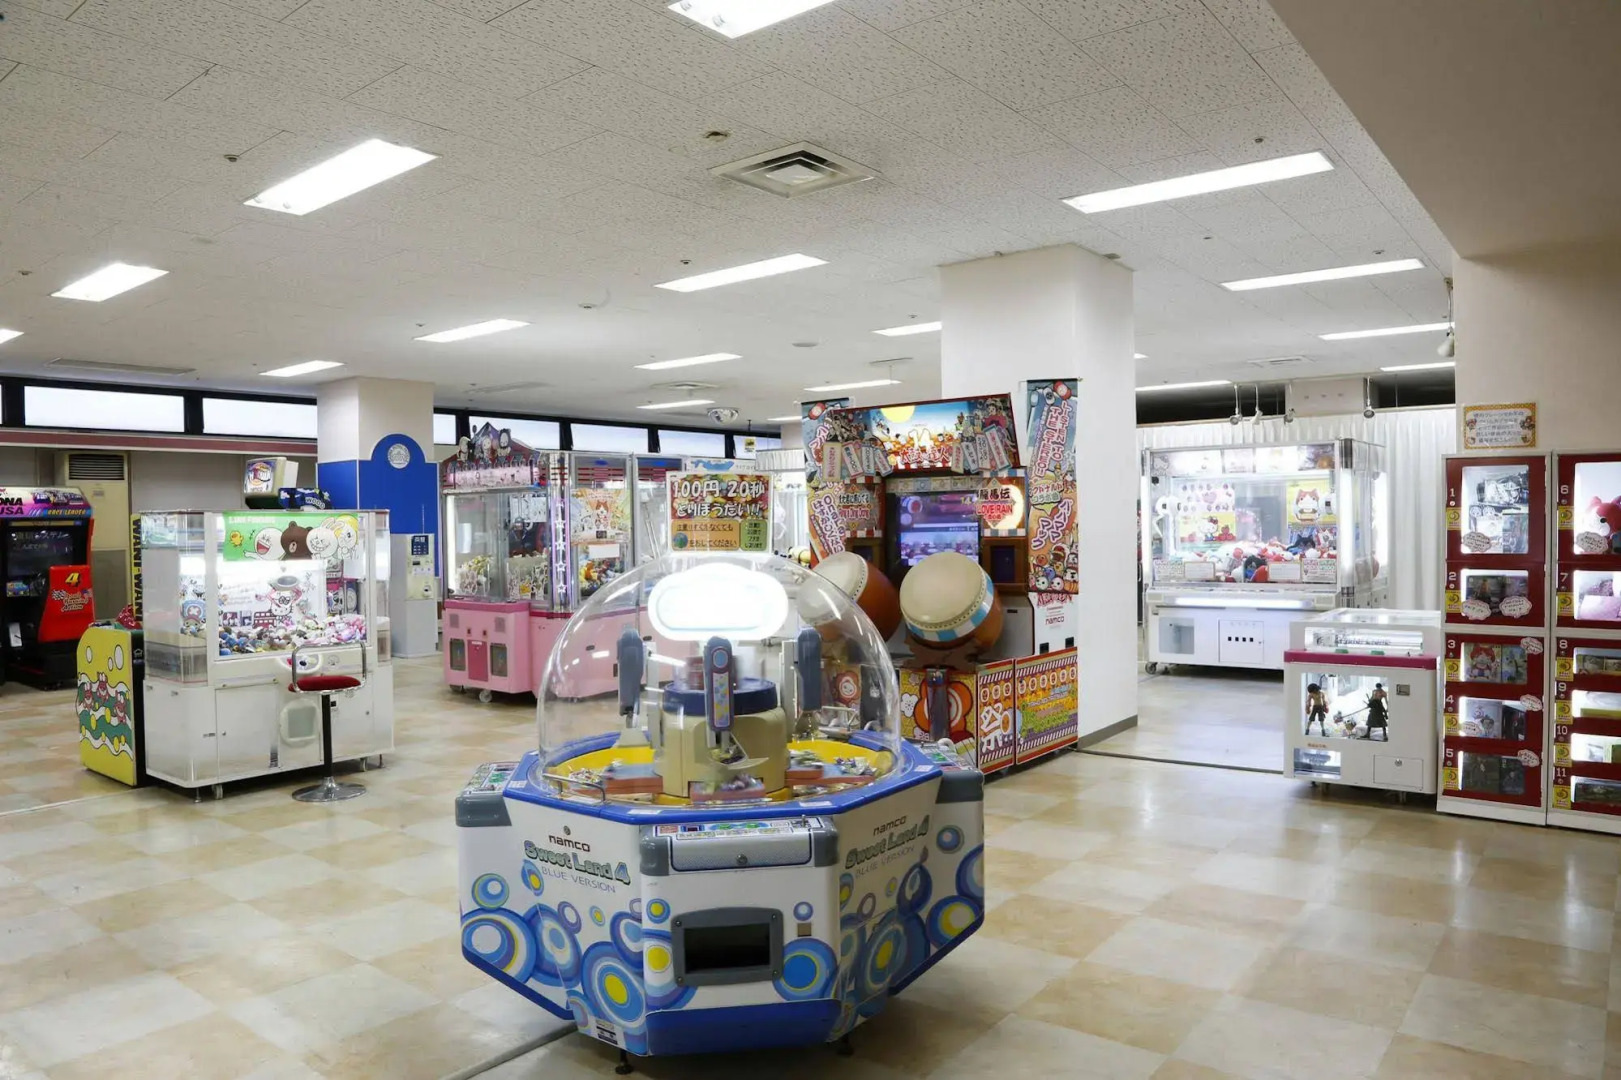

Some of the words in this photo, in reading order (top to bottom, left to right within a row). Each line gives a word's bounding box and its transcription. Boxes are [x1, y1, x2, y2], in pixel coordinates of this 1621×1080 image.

[1046, 406, 1061, 429] THE
[1056, 401, 1072, 444] LISTEN
[1051, 444, 1064, 461] TO
[673, 481, 720, 498] 100円
[727, 481, 765, 498] 20秒
[1450, 488, 1455, 497] 1
[1560, 485, 1569, 494] 6
[996, 504, 1013, 514] RAIN
[65, 572, 80, 588] 4
[1449, 572, 1457, 581] 2
[1560, 572, 1568, 582] 7
[1447, 639, 1456, 648] 3
[1559, 639, 1568, 649] 8
[1558, 682, 1567, 691] 9
[1446, 695, 1454, 704] 4
[1556, 725, 1567, 735] 10
[1445, 748, 1453, 757] 5
[1556, 768, 1566, 777] 11
[873, 815, 907, 836] namco
[887, 823, 918, 851] Land
[549, 835, 591, 852] namco
[524, 840, 572, 869] Sweet
[572, 852, 614, 880] Land
[541, 866, 568, 880] BLUE
[571, 875, 616, 893] VERSION
